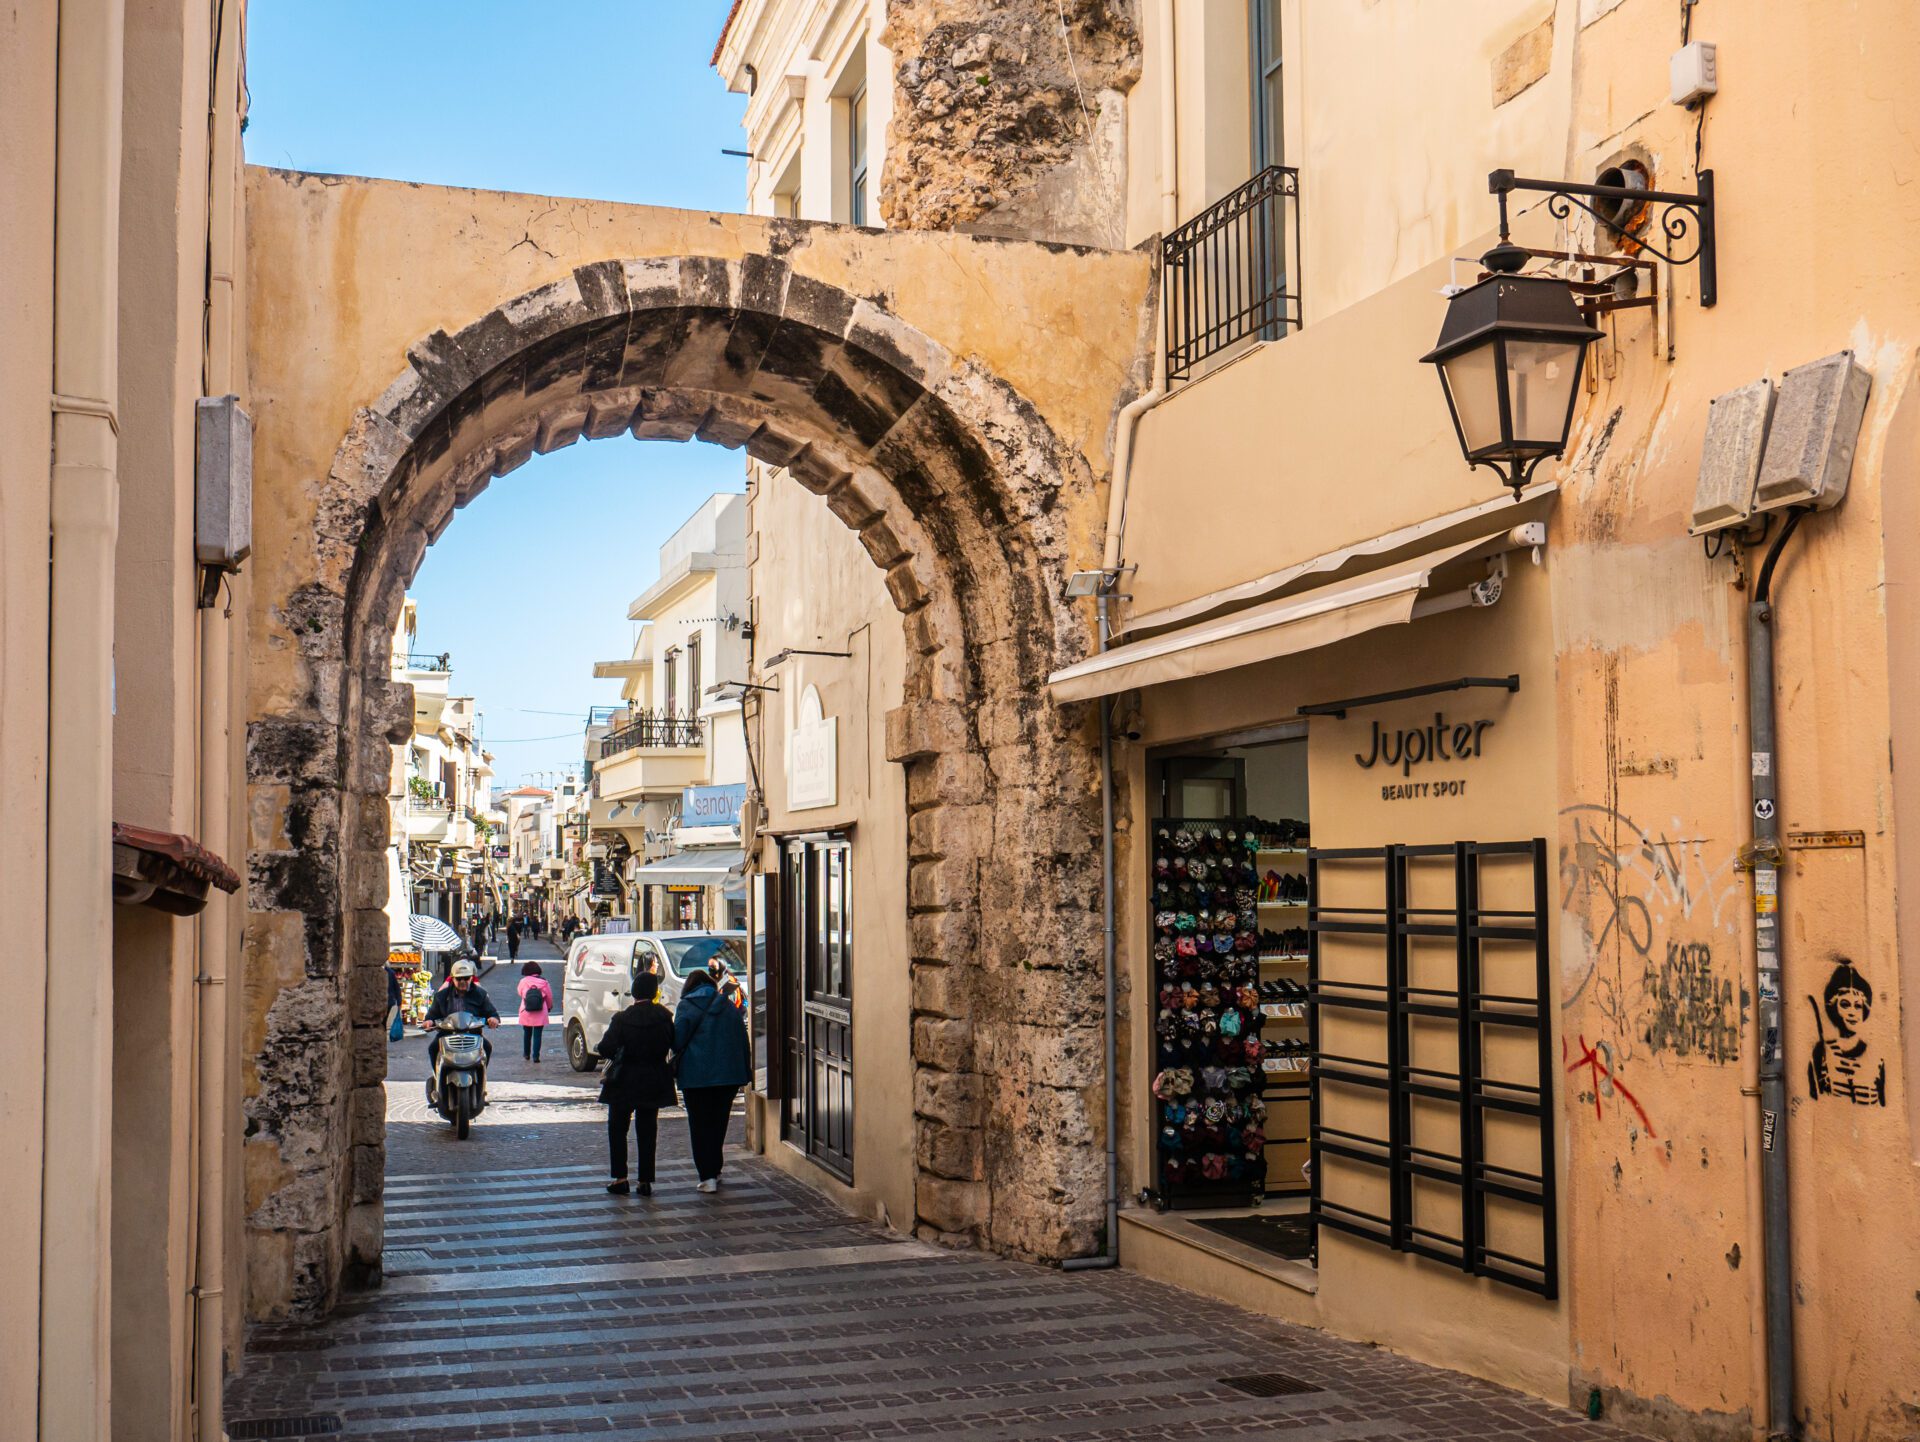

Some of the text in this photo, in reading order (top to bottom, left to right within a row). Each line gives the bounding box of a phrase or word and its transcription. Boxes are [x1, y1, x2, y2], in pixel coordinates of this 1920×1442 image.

[1354, 711, 1495, 777] Jupiter
[695, 790, 733, 821] sandy
[1381, 779, 1467, 801] BEAUTY SPOT
